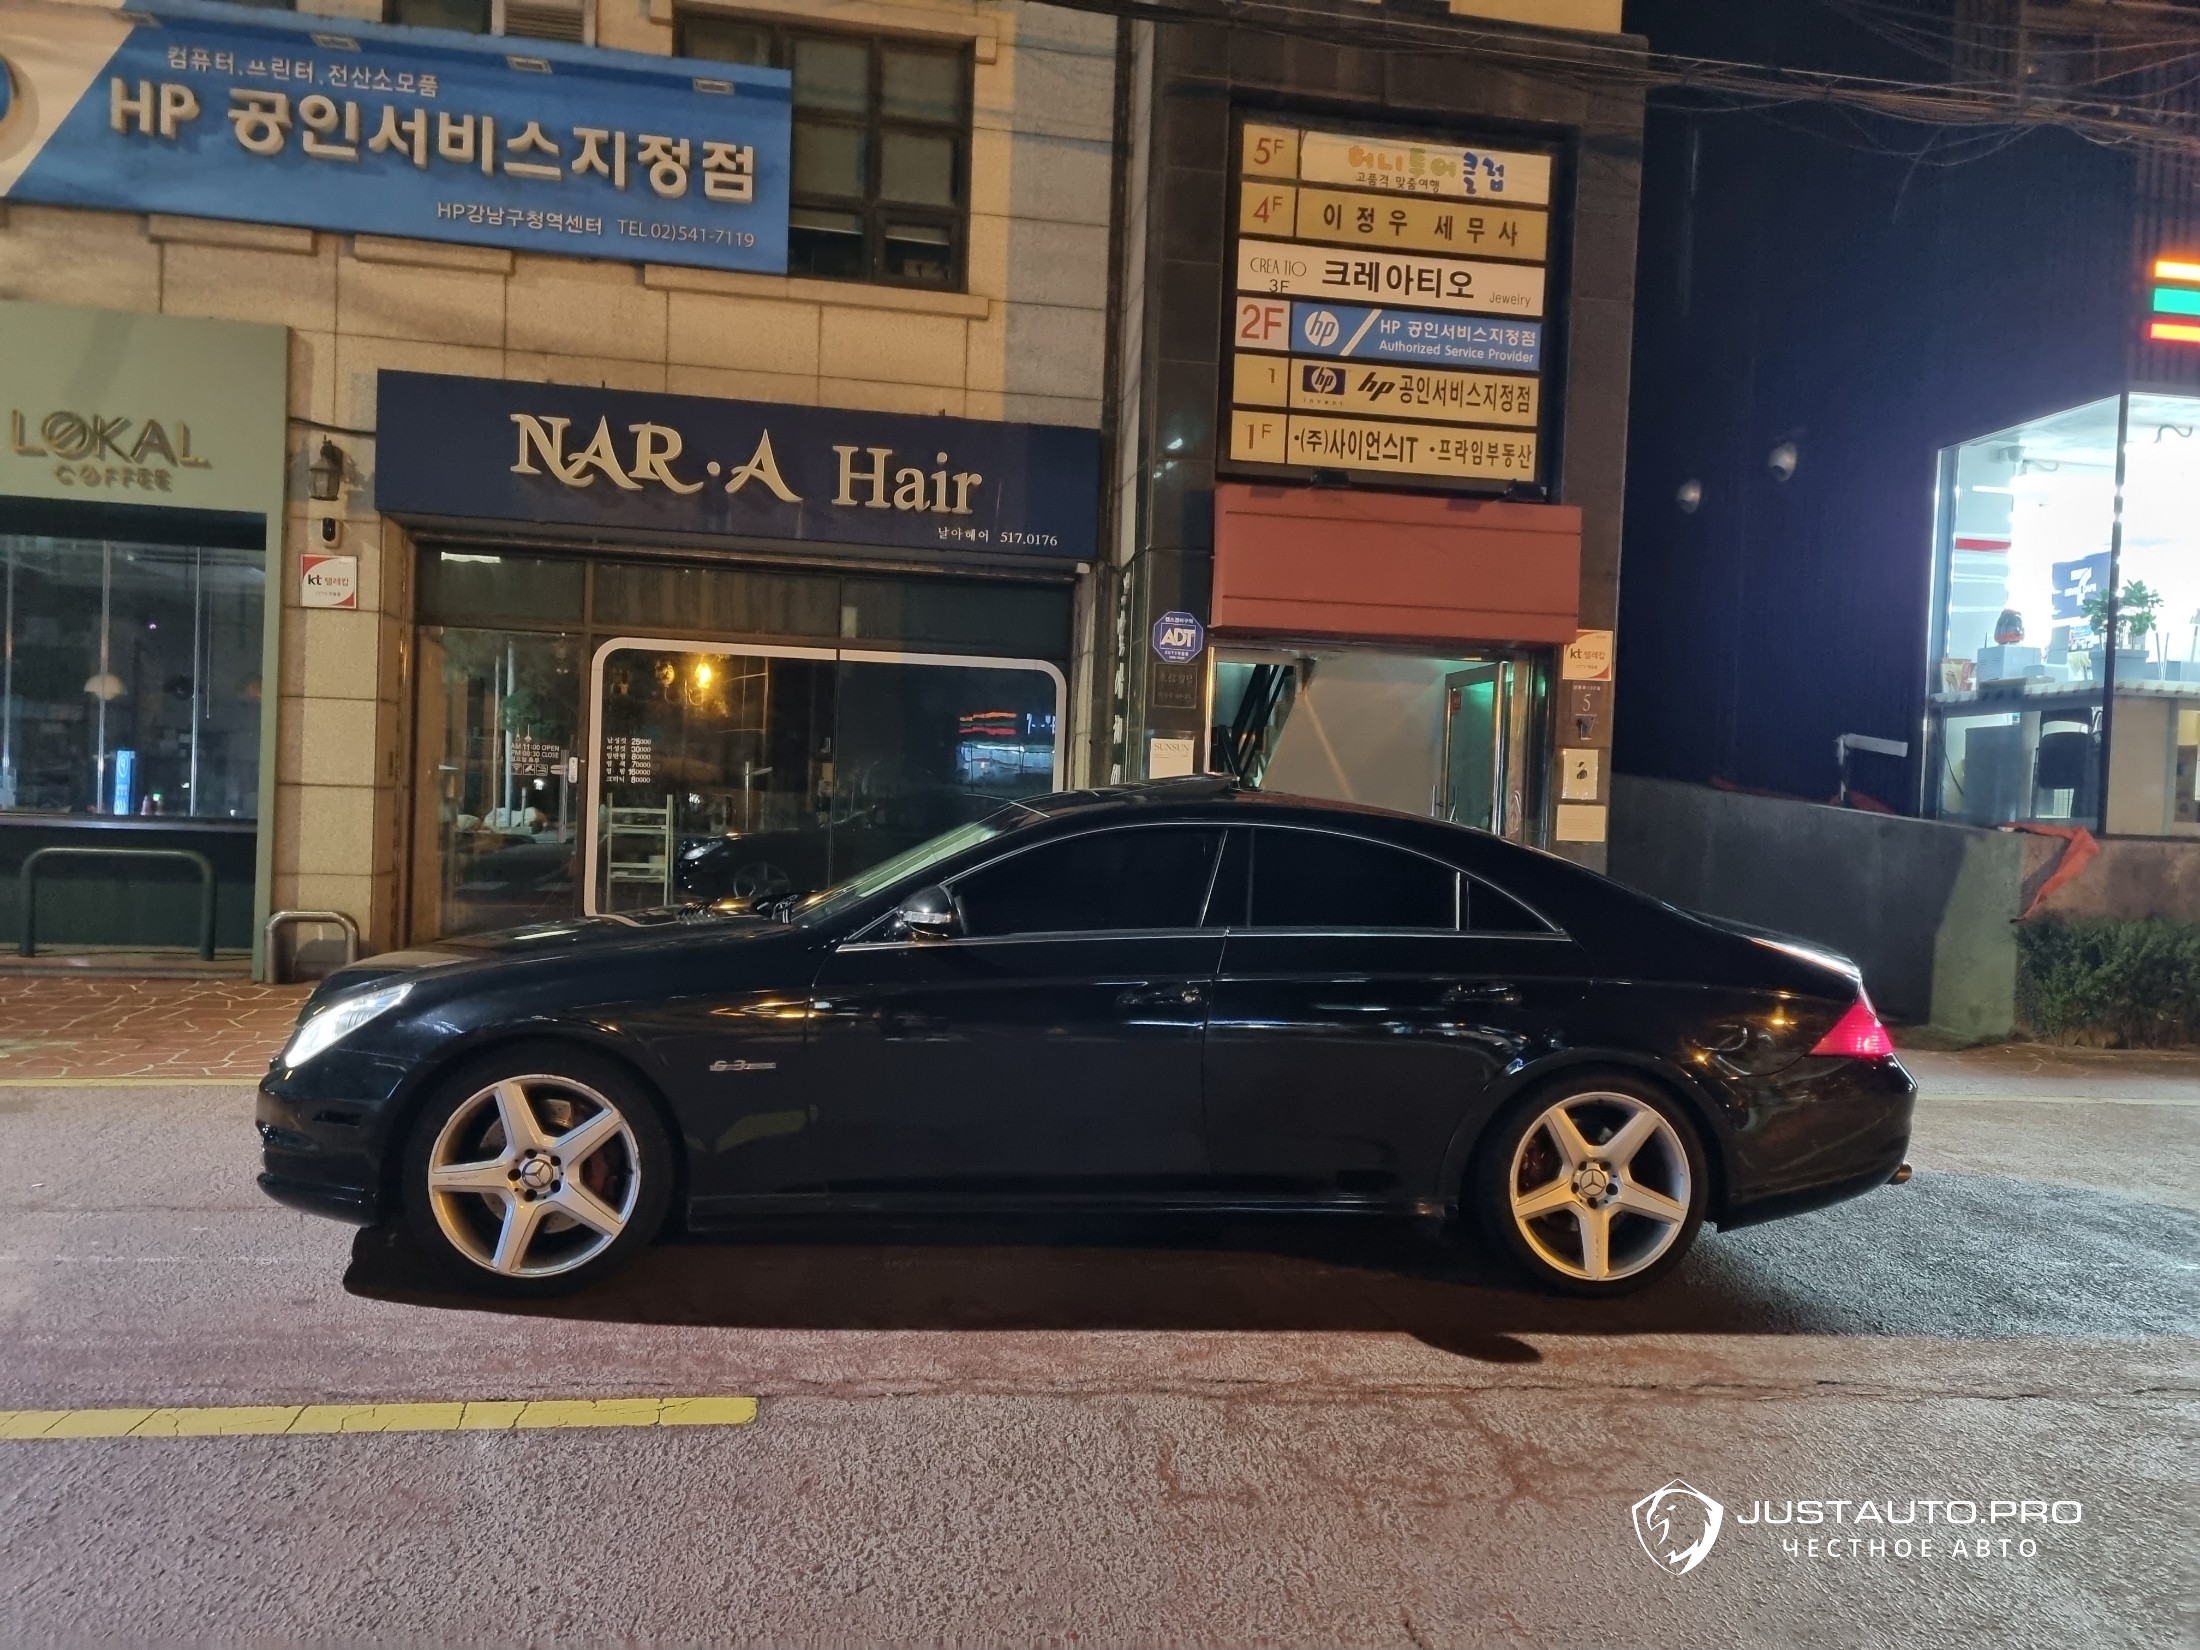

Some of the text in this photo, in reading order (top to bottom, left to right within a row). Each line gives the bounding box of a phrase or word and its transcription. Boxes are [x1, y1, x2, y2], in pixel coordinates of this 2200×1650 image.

[110, 77, 755, 203] HP 공인서비스지정점
[1253, 137, 1285, 165] 5F
[1355, 172, 1441, 193] 고품격 맞춤여행
[437, 201, 603, 236] HP강남구청역센터
[617, 219, 648, 238] TEL
[1252, 195, 1284, 224] 4F
[1323, 203, 1518, 246] 이정우 세무사
[1269, 278, 1290, 293] 3F
[1322, 259, 1531, 308] 크레아티오 Jewelry
[1240, 303, 1285, 340] 2F
[1307, 311, 1336, 347] hp
[1380, 319, 1536, 347] HP 공인서비스지정점
[1379, 340, 1534, 363] Authorized Service Provider
[831, 445, 984, 515] Hair
[1000, 531, 1058, 546] 517.0176
[307, 574, 322, 586] kt
[1160, 627, 1196, 648] ADT
[1569, 648, 1582, 660] kt
[541, 744, 560, 752] OPEN
